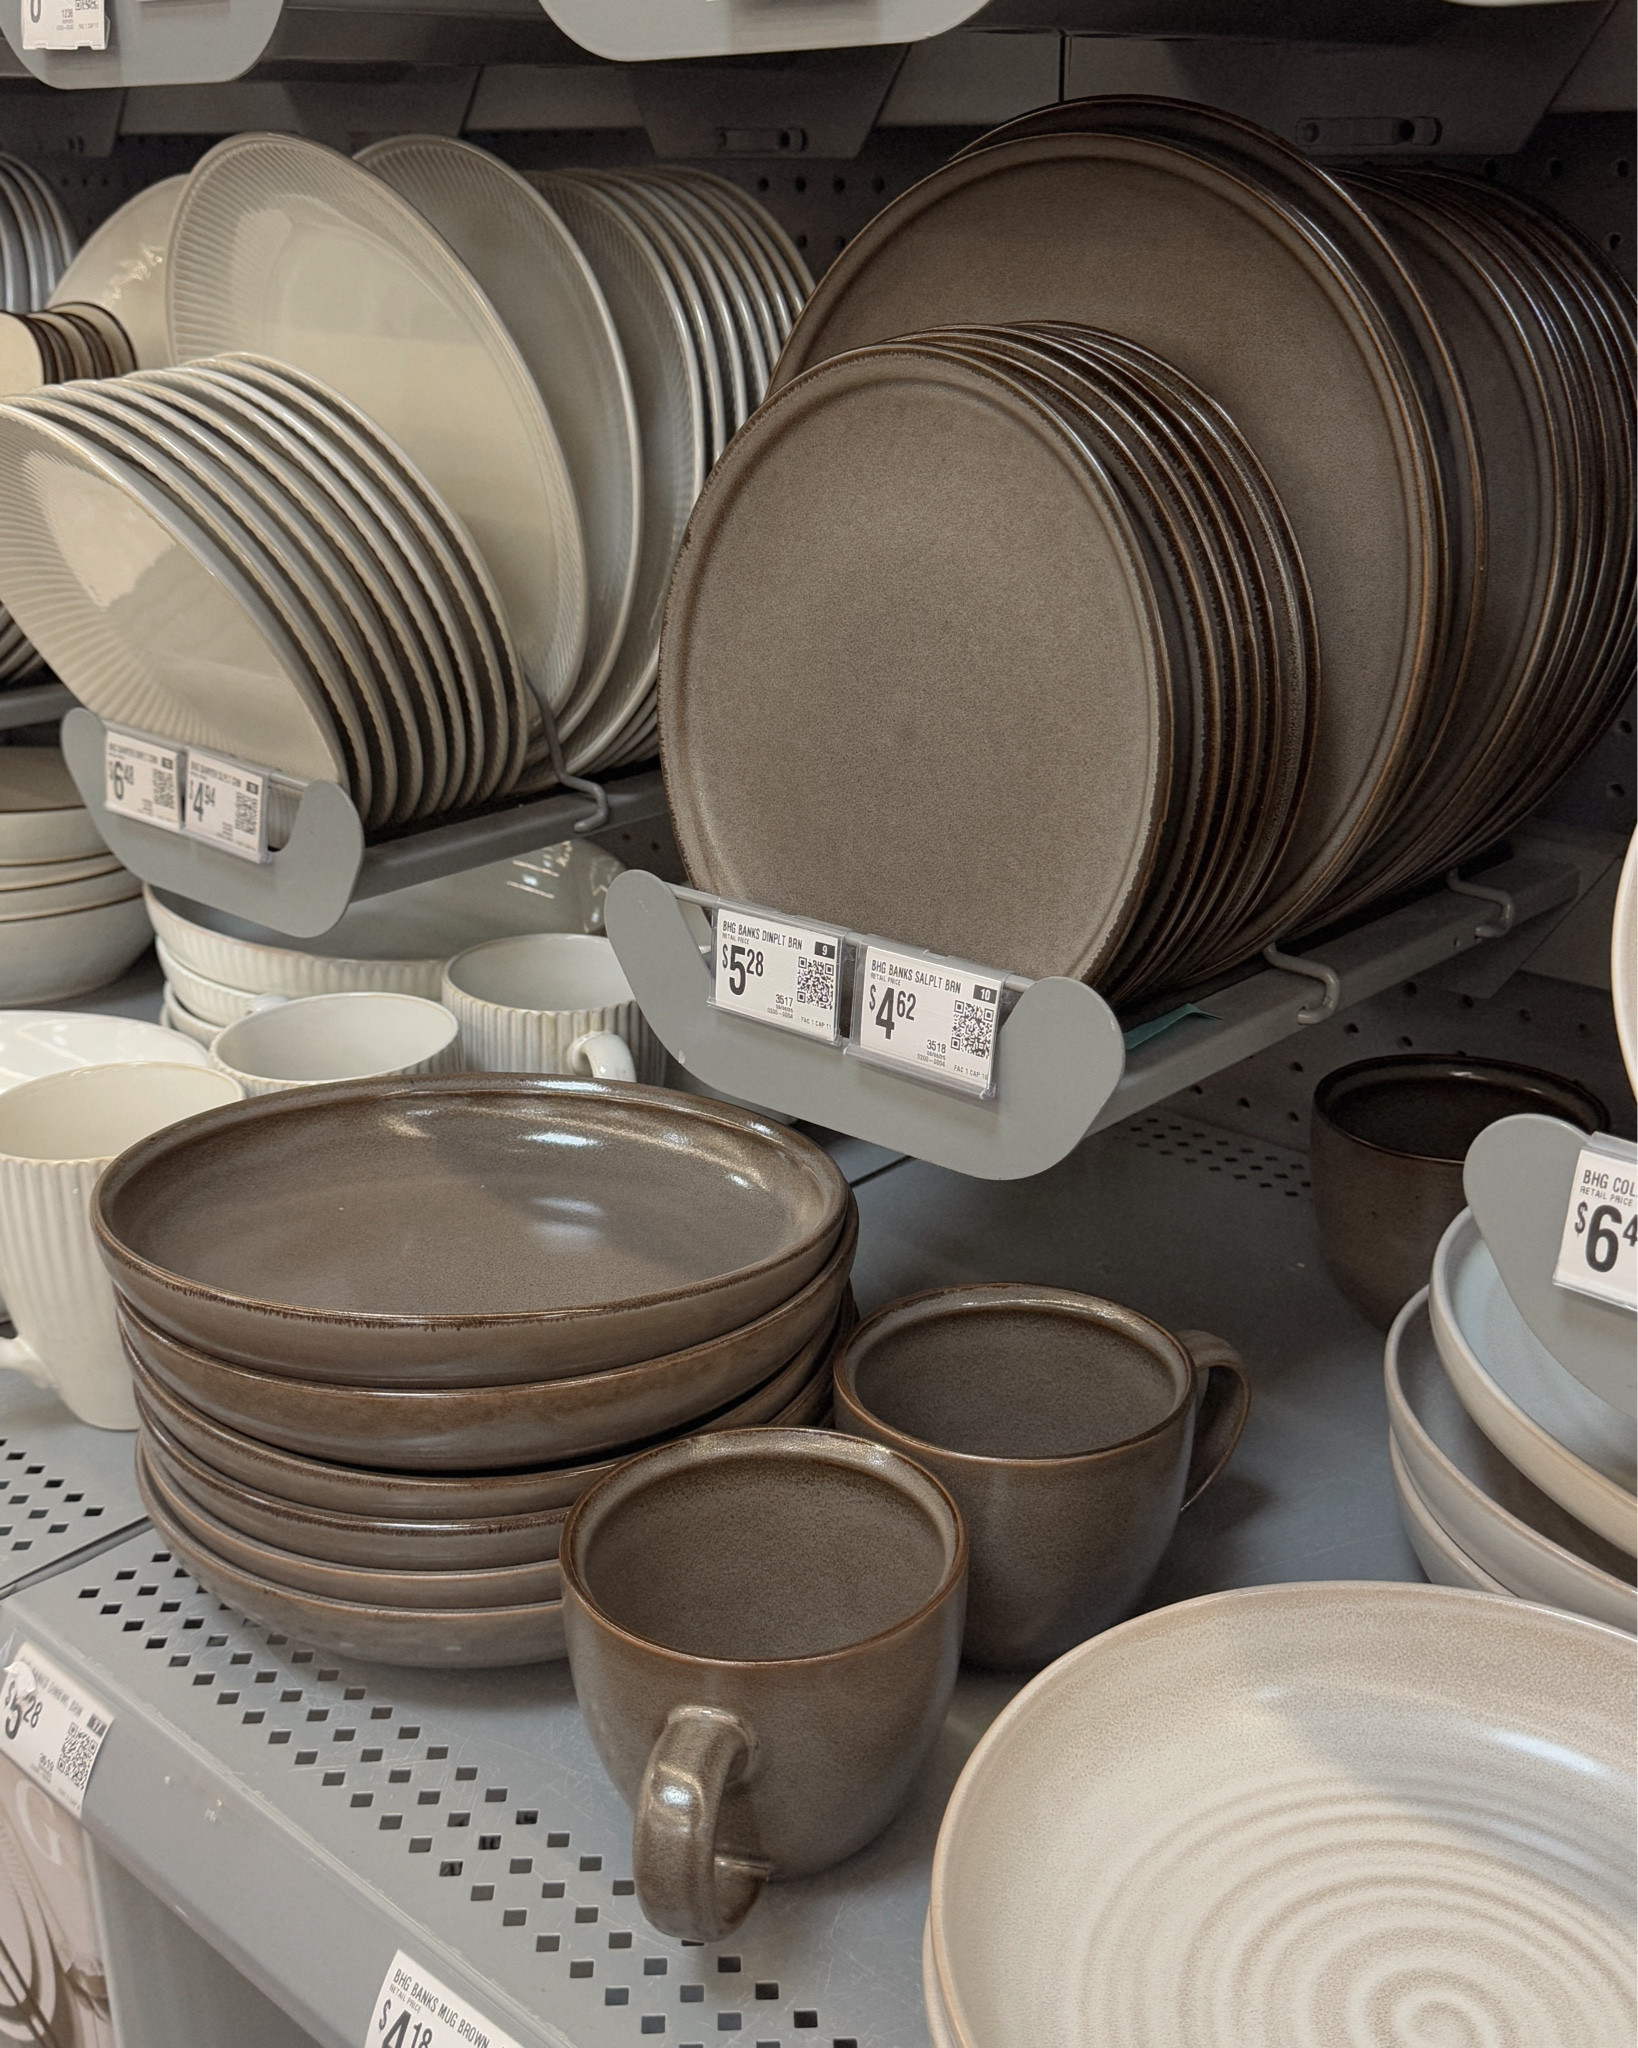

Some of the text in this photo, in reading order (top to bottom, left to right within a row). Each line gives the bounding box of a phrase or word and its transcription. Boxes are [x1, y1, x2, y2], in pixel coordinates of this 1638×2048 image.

[721, 932, 737, 942] RETAIL
[722, 920, 803, 951] BHG BANKS DINPLT BRN
[822, 945, 828, 956] 9
[870, 973, 901, 986] RETAIL PRICE
[871, 959, 961, 994] BHG BANKS SALPLT BRN
[775, 993, 794, 1007] 3517
[980, 988, 991, 1001] 10
[926, 1039, 947, 1054] 3518
[969, 1069, 981, 1078] CAP
[1582, 1169, 1638, 1198] BHG COL
[1580, 1185, 1633, 1207] RETAIL PRICE
[389, 1984, 422, 2014] RETAIL PRICE
[393, 1968, 490, 2048] BHG BANKS MUG BROWN
